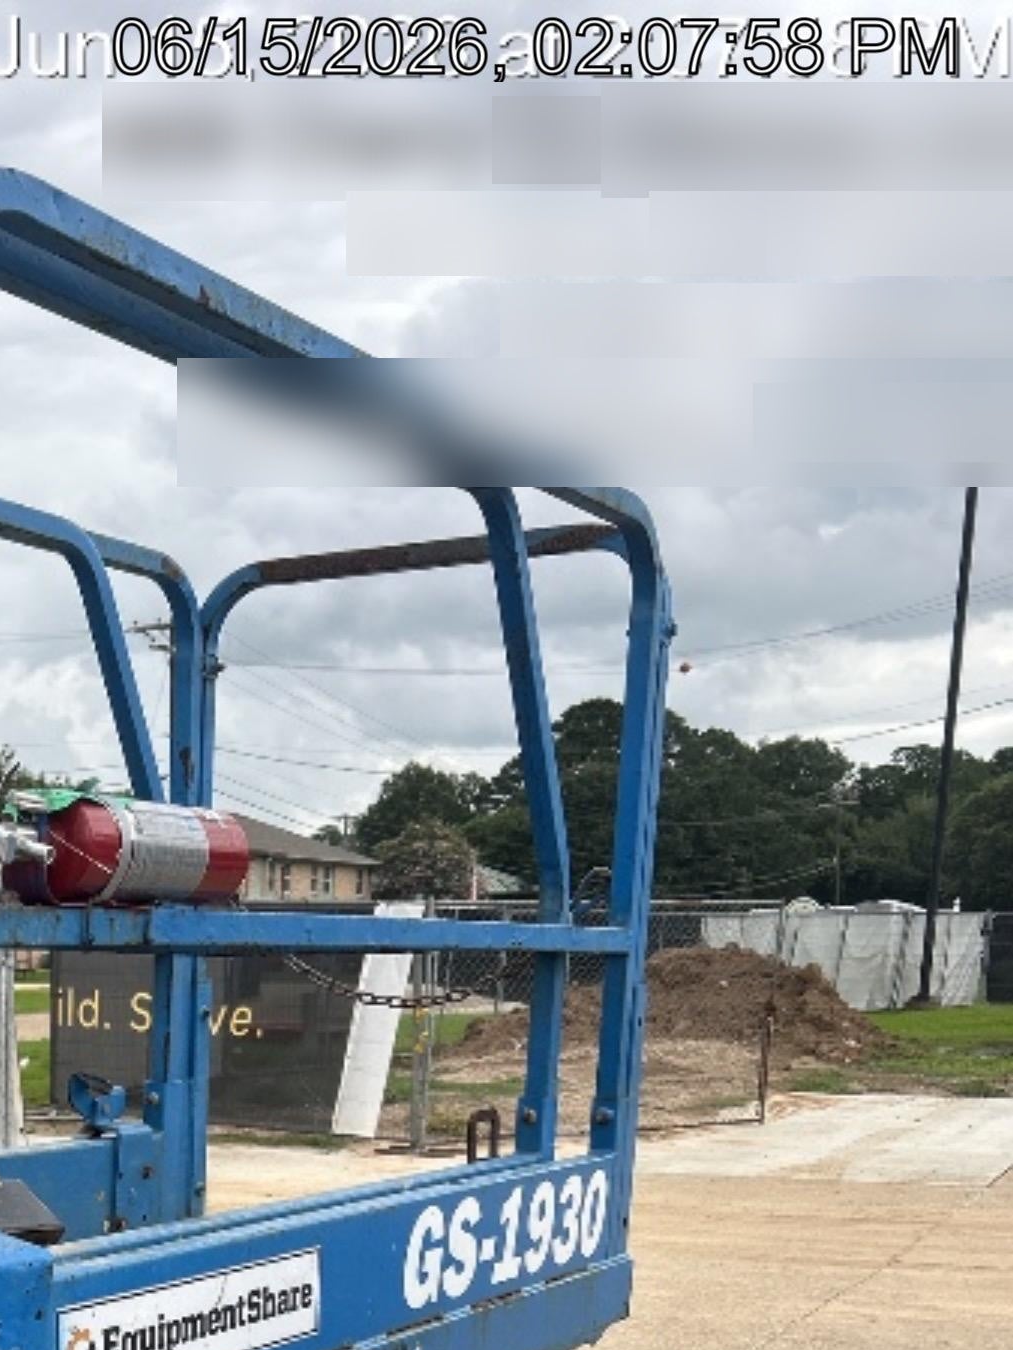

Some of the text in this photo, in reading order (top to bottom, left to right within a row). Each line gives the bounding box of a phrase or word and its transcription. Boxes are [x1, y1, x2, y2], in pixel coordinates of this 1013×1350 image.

[57, 986, 264, 1038] ild. Sve.
[403, 1169, 608, 1309] GS-1930
